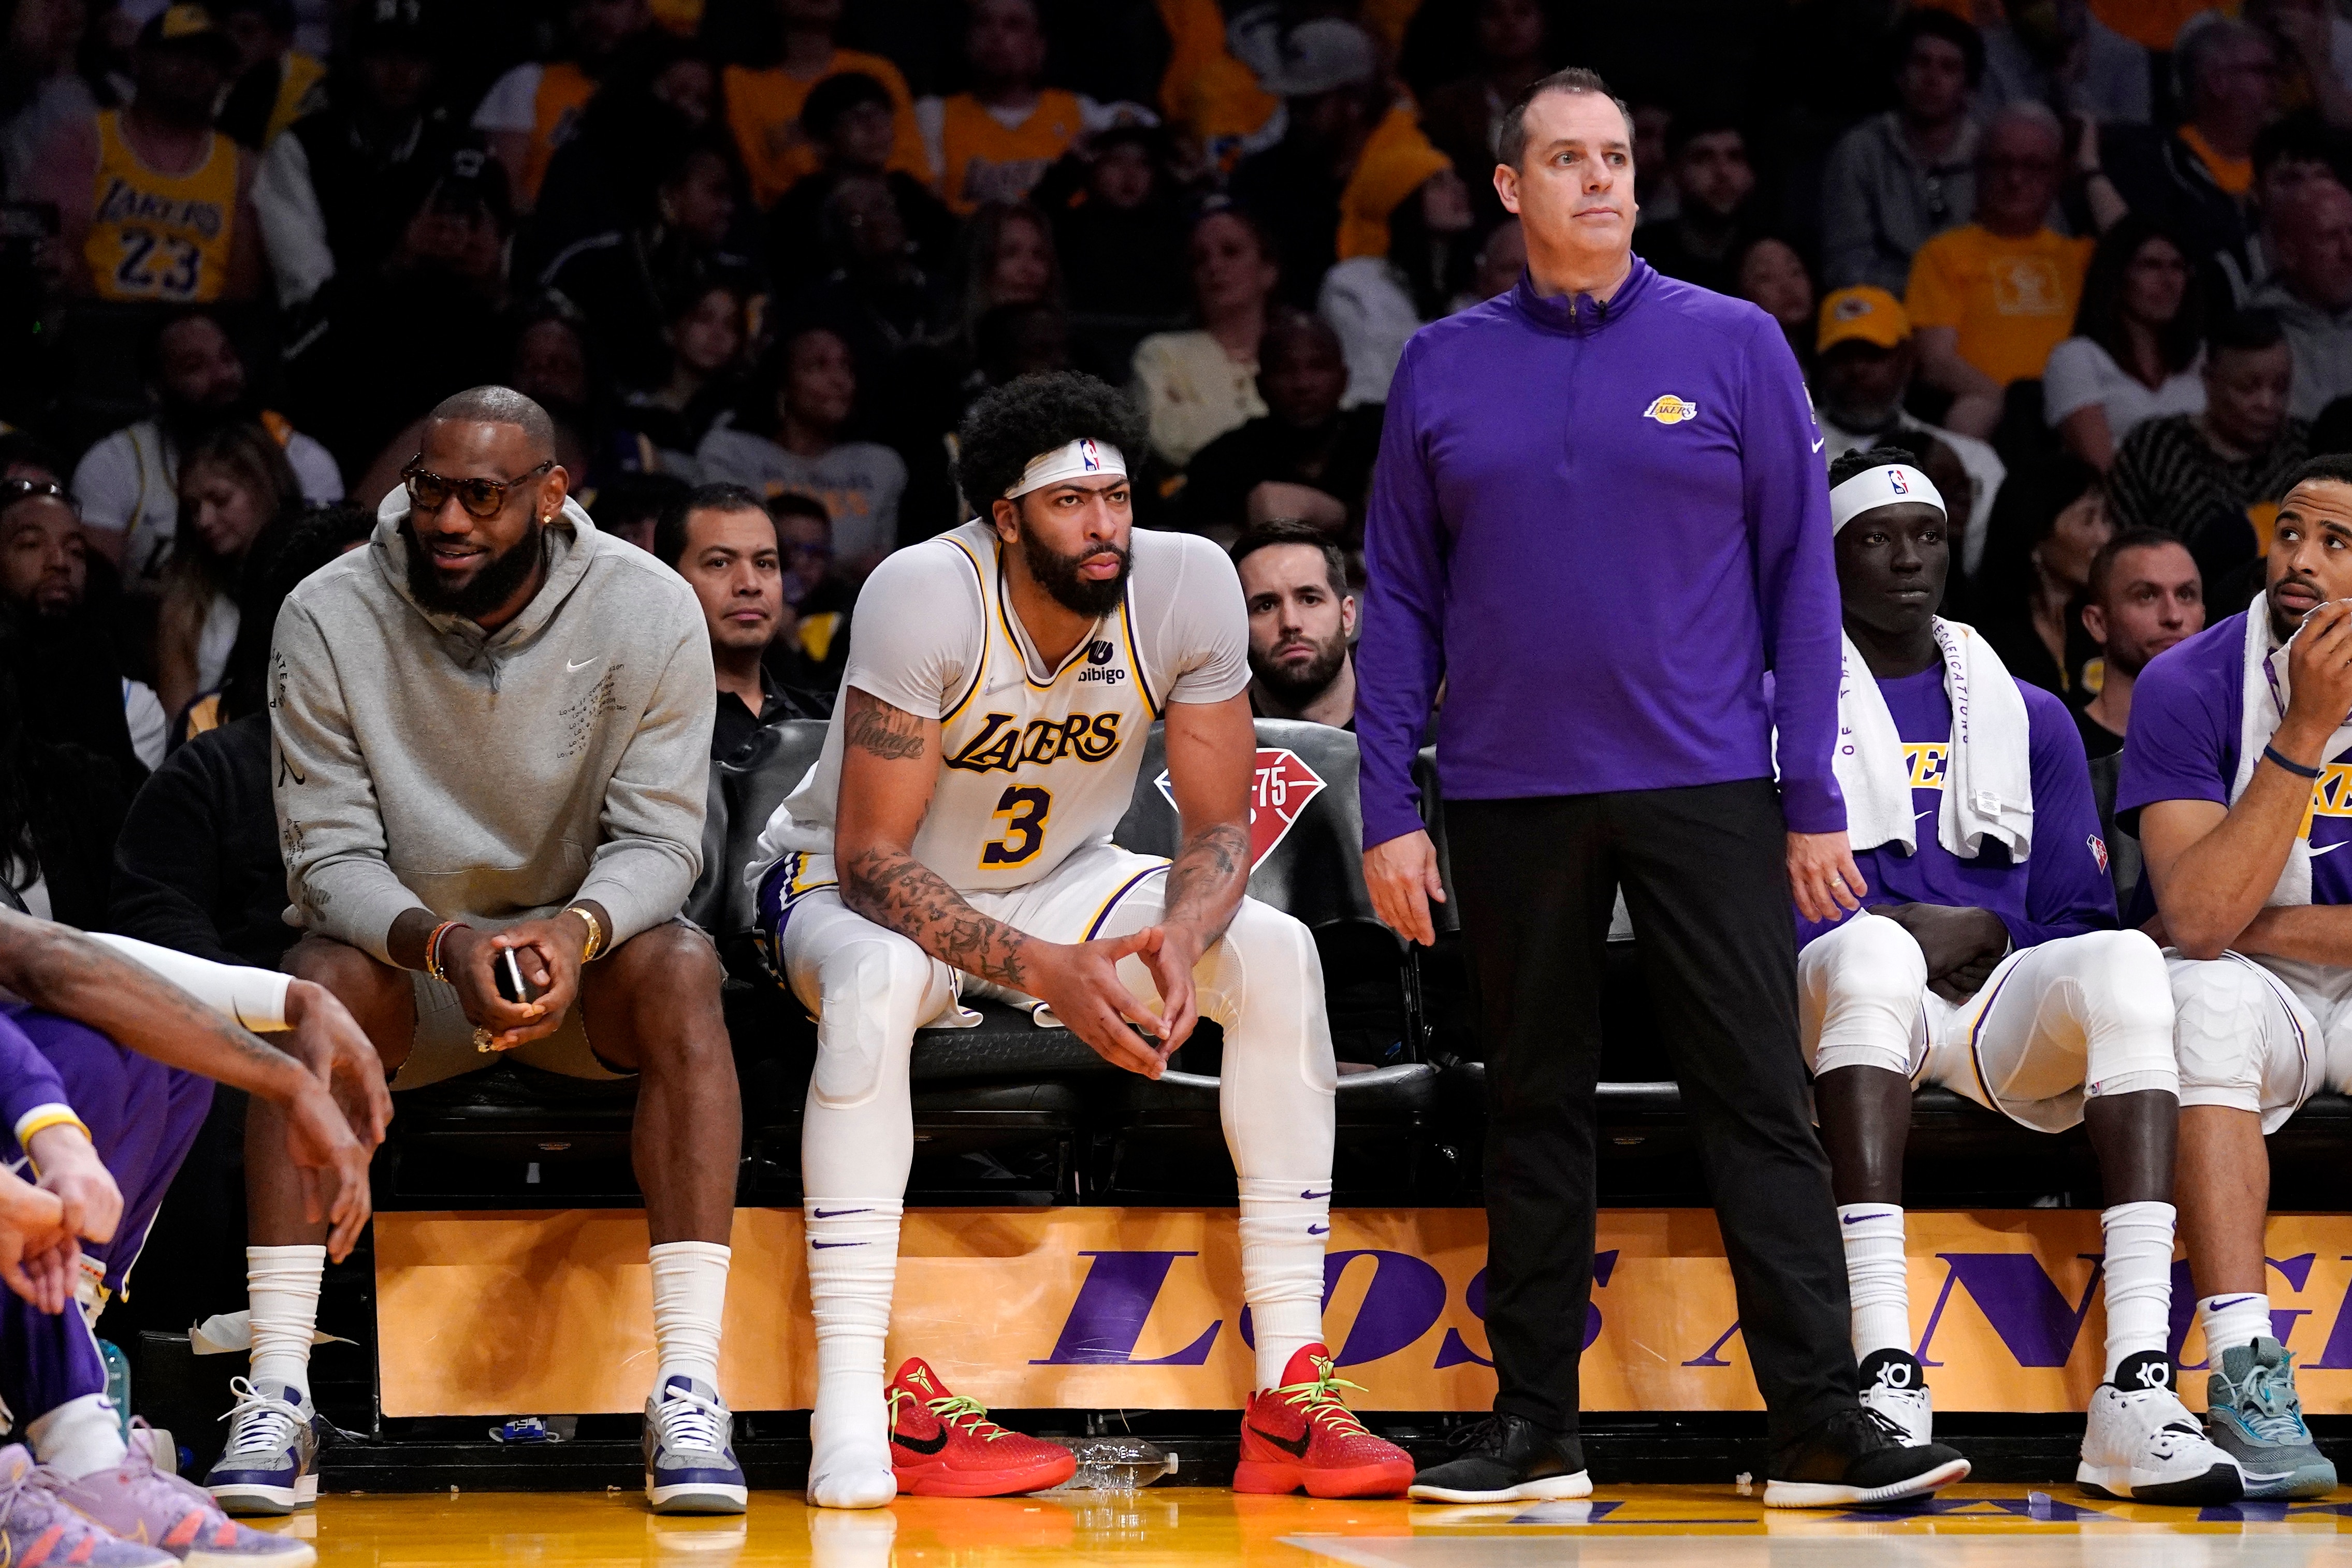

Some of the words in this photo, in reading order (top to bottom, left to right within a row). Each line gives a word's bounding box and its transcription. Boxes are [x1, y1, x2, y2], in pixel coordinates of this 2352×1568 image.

[115, 228, 202, 301] 23
[1649, 401, 1696, 419] LAKERS
[978, 783, 1054, 871] 3
